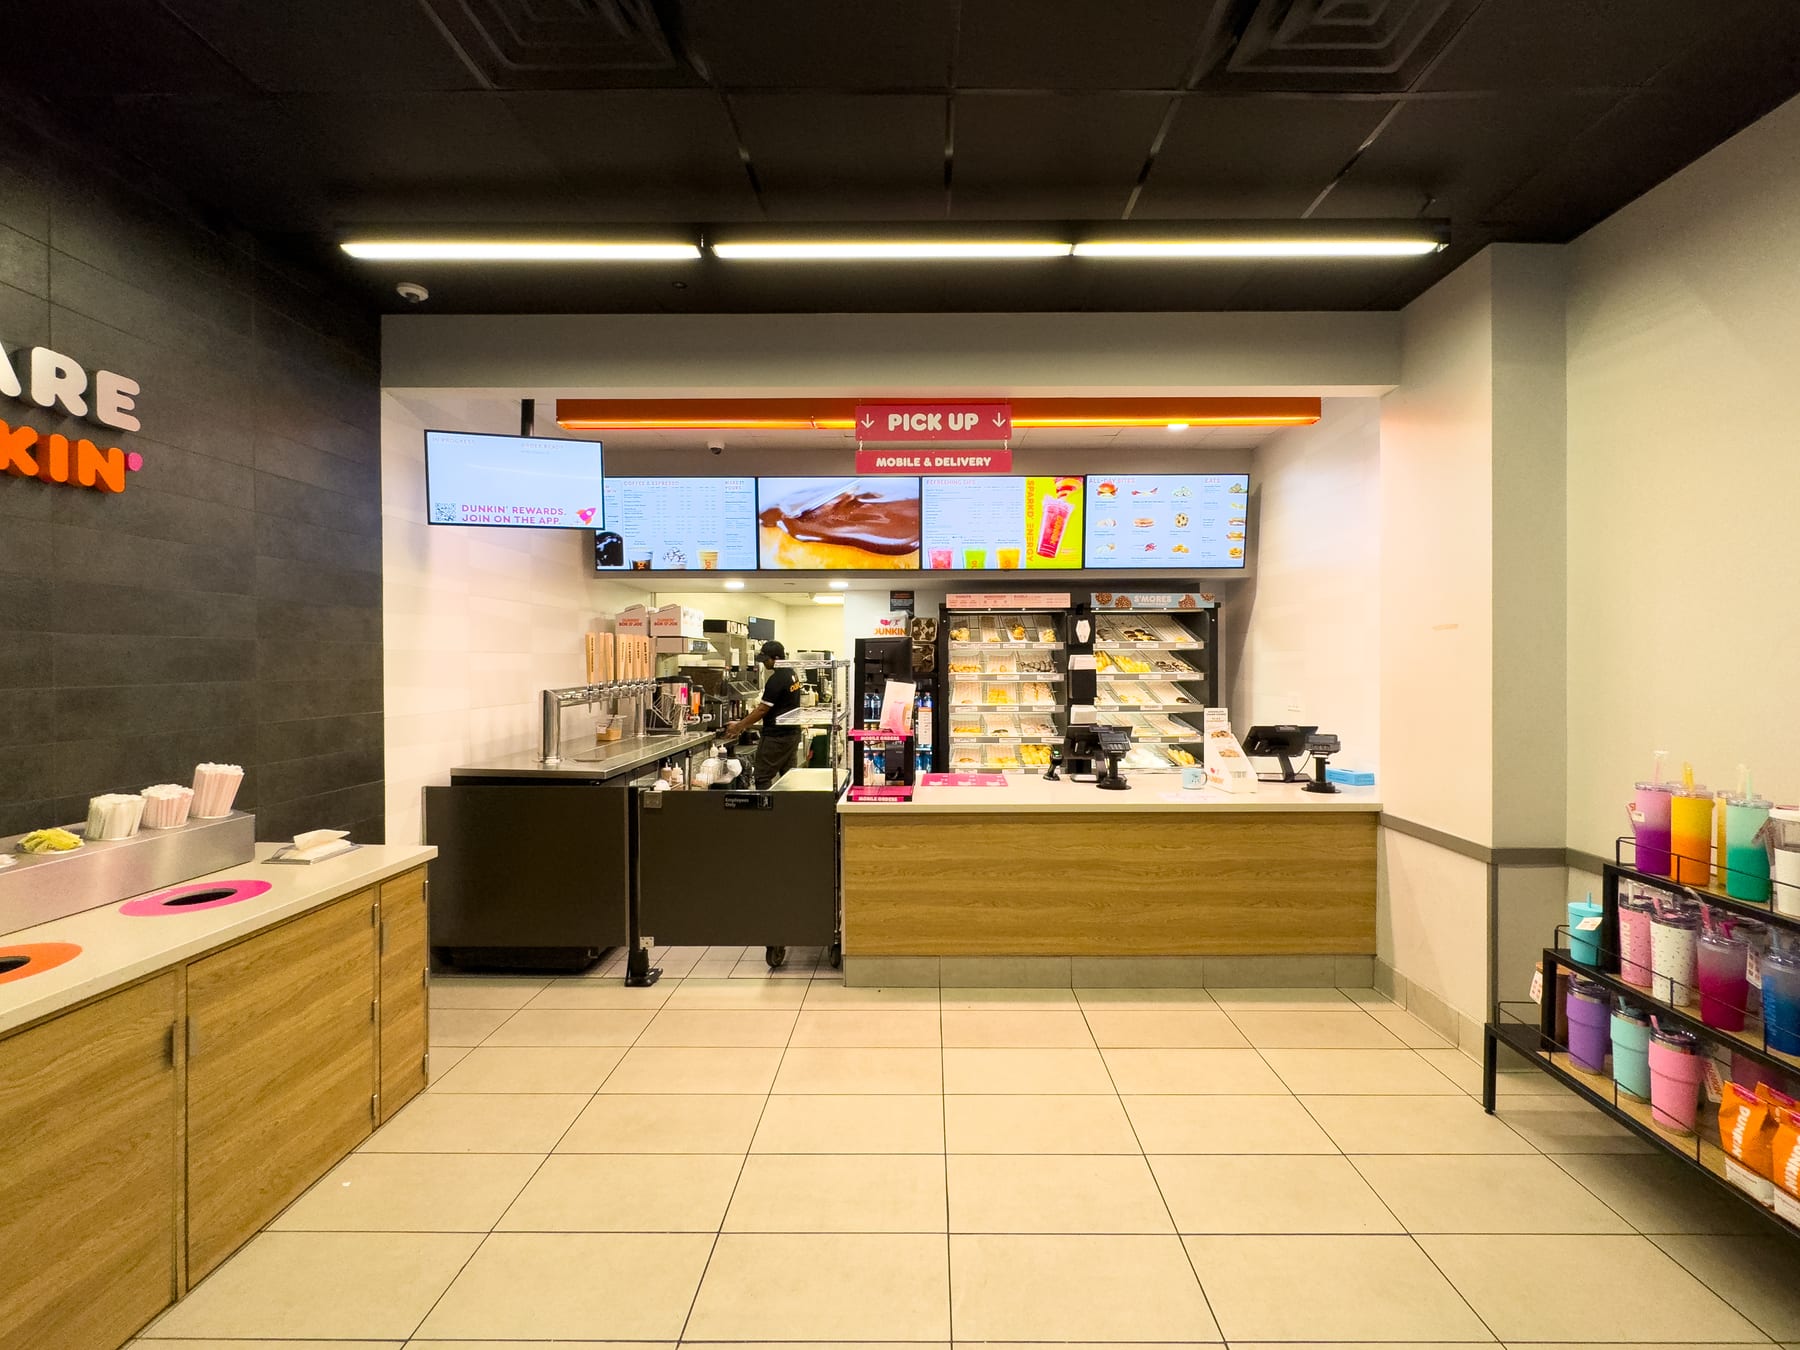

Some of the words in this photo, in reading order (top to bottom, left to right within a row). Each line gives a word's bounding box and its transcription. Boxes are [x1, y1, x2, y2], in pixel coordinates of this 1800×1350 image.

[888, 413, 943, 432] PICK
[948, 413, 980, 431] UP
[876, 457, 921, 467] MOBILE
[923, 457, 933, 467] &
[935, 457, 992, 467] DELIVERY
[462, 514, 490, 523] JOIN
[494, 515, 511, 524] ON
[514, 515, 537, 525] THE
